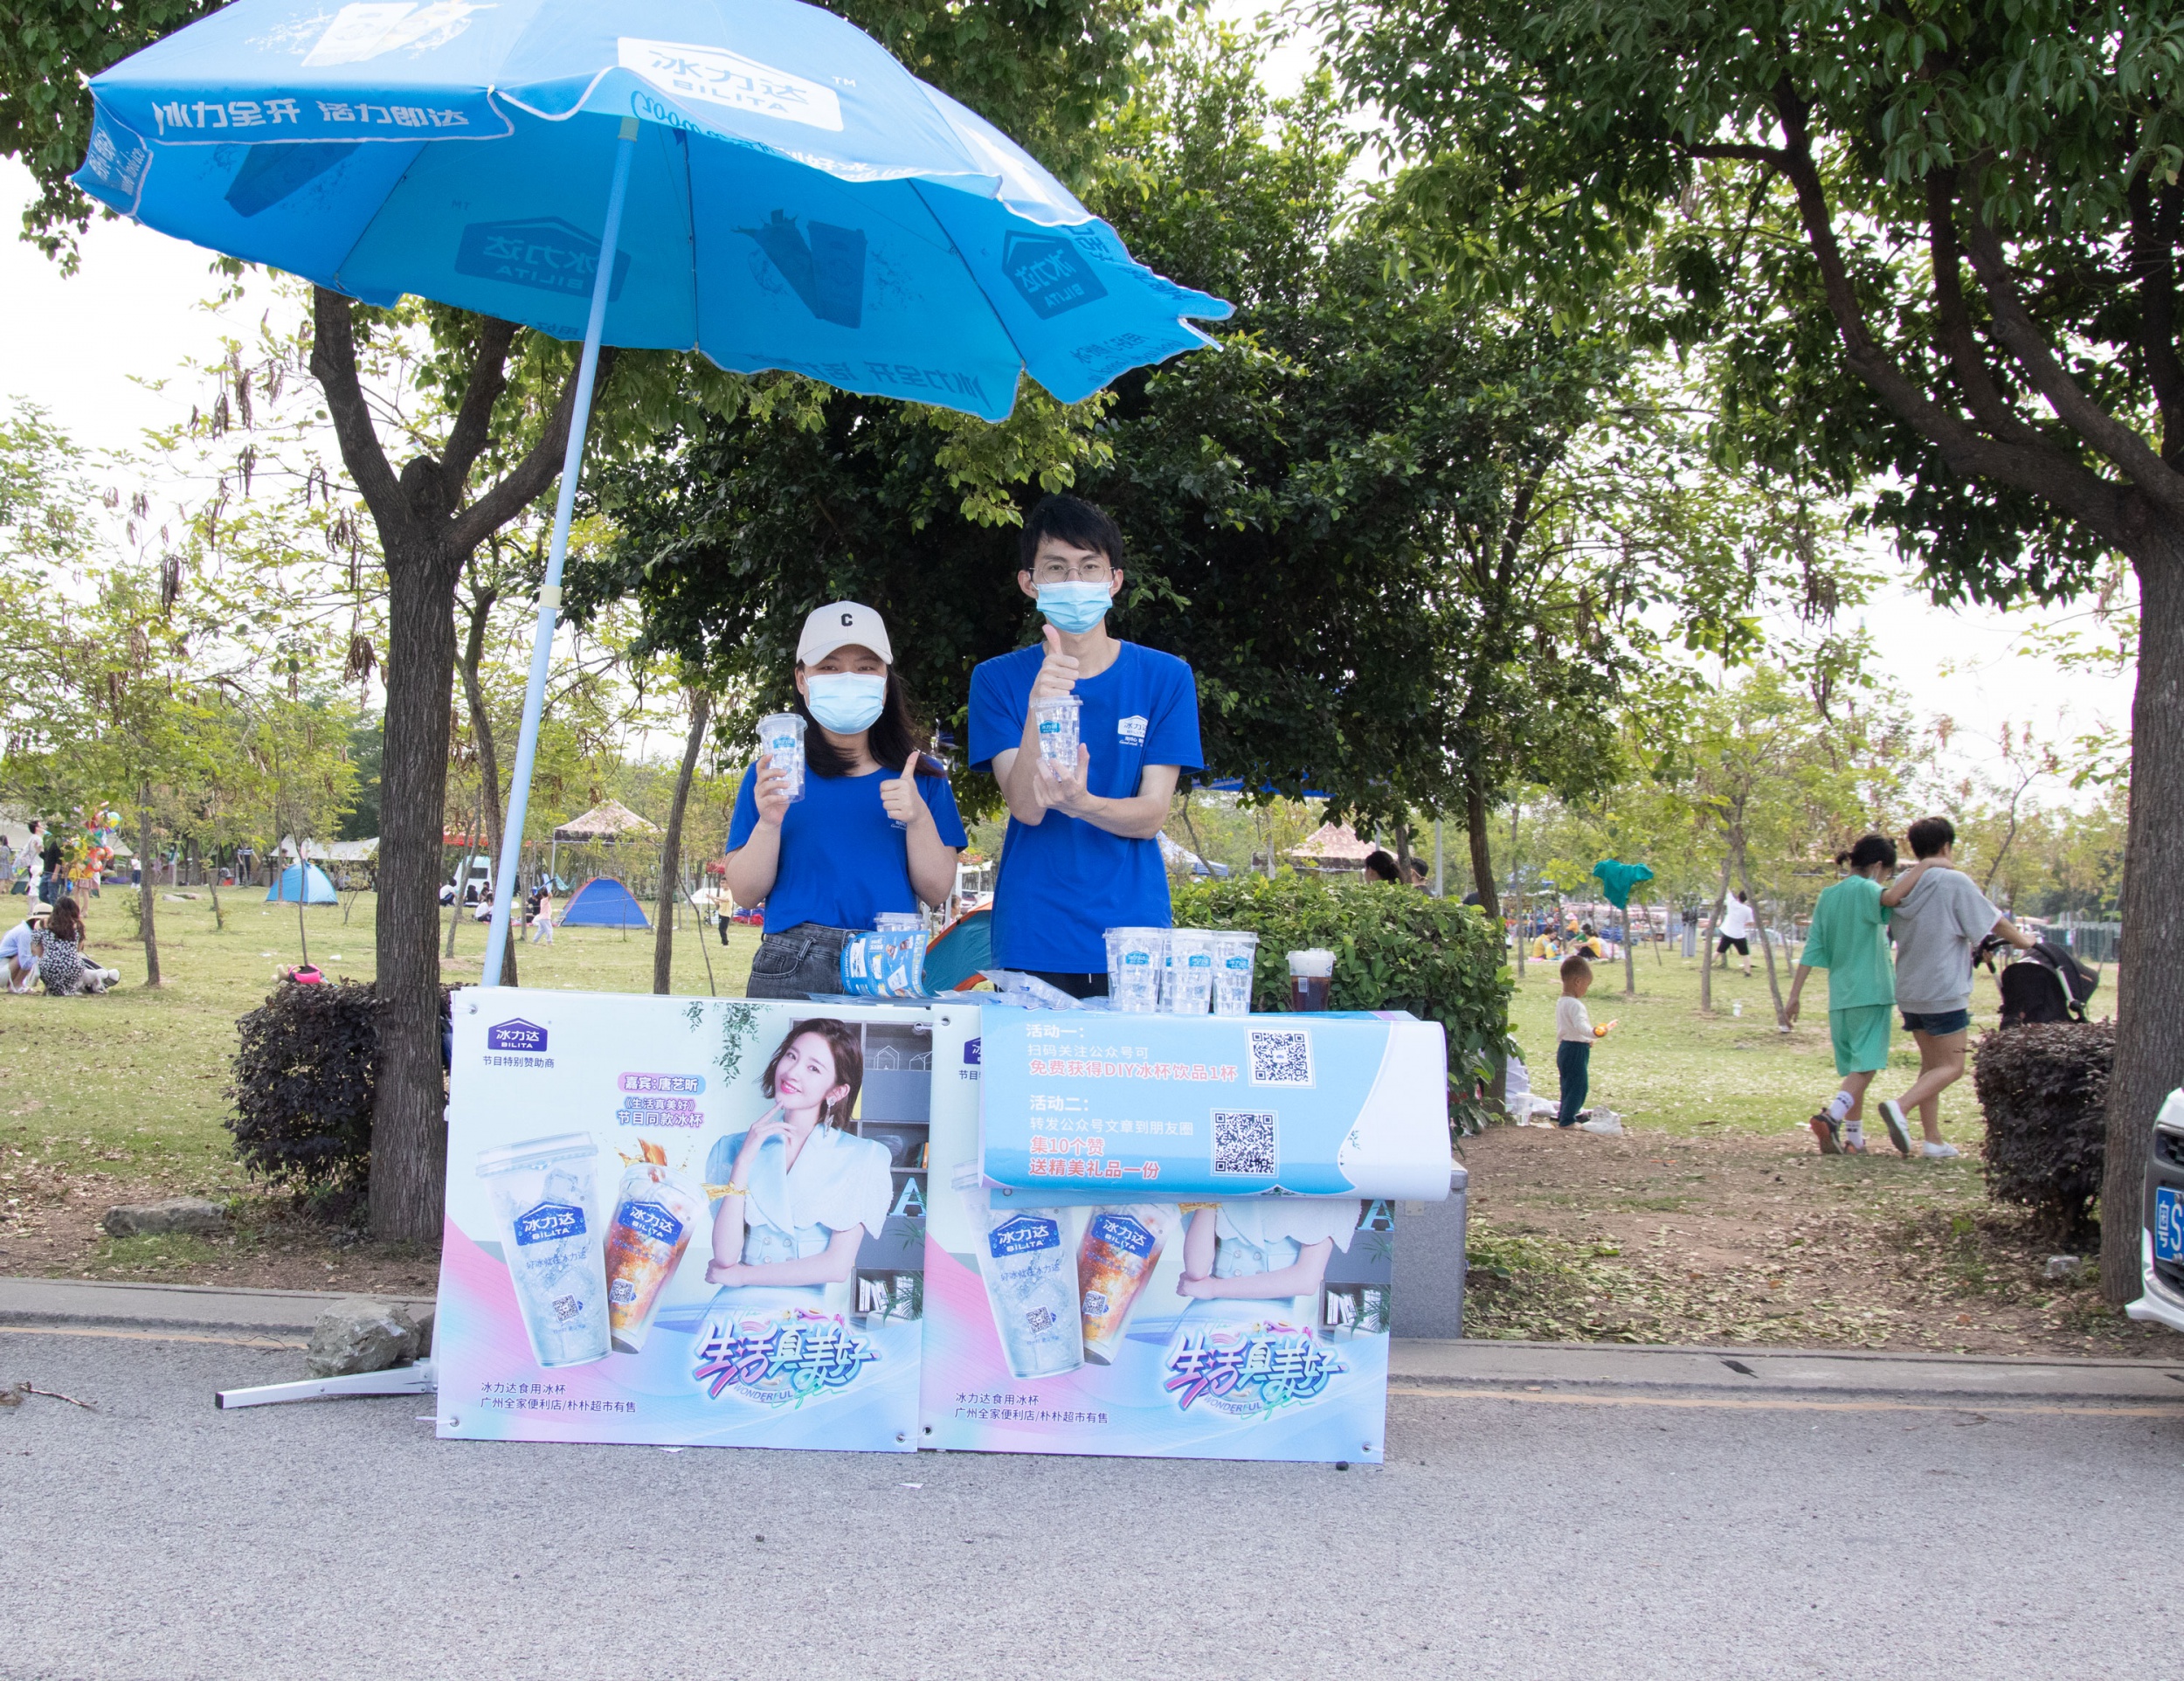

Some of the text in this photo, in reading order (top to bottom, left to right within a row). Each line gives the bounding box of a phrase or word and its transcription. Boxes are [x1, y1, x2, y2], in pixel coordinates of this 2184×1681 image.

[648, 50, 809, 105] 冰力达
[832, 75, 856, 87] TM
[673, 80, 788, 113] BILITA
[152, 98, 469, 136] 冰力全开 活力即达
[841, 613, 853, 626] C
[496, 1029, 540, 1042] 冰力达
[1026, 1023, 1084, 1038] 活动一：
[1027, 1043, 1149, 1059] 扫码关注公众号可
[483, 1055, 555, 1069] 节目特别赞助商
[958, 1069, 981, 1080] 节目
[1029, 1059, 1238, 1082] 免费获得DIY冰杯饮品1杯
[625, 1075, 699, 1092] 嘉宾:唐艺昕
[624, 1097, 695, 1111] 《生活真美好》
[1029, 1095, 1089, 1112] 活动二：
[617, 1110, 703, 1127] 节目同款冰杯
[1030, 1136, 1105, 1157] 集10个赞
[1029, 1159, 1160, 1179] 送精美礼品一份
[523, 1213, 576, 1232] 冰力达
[630, 1206, 674, 1233] 冰力达
[532, 1228, 570, 1241] BILITA
[632, 1221, 663, 1237] BILITA
[998, 1225, 1049, 1245] 冰力达
[1102, 1219, 1147, 1247] 冰力达
[1006, 1241, 1044, 1252] BILITA
[1105, 1234, 1136, 1250] BILITA
[695, 1319, 881, 1400] 生活真美好
[1166, 1333, 1348, 1410] 生活真美好
[480, 1382, 566, 1395] 冰力达食用冰杯
[733, 1384, 794, 1401] WONDERFUL
[480, 1397, 637, 1413] 广州全家便利店/朴朴超市有售
[956, 1393, 1040, 1406] 冰力达食用冰杯
[954, 1408, 1109, 1424] 广州全家便利店/朴朴超市有售
